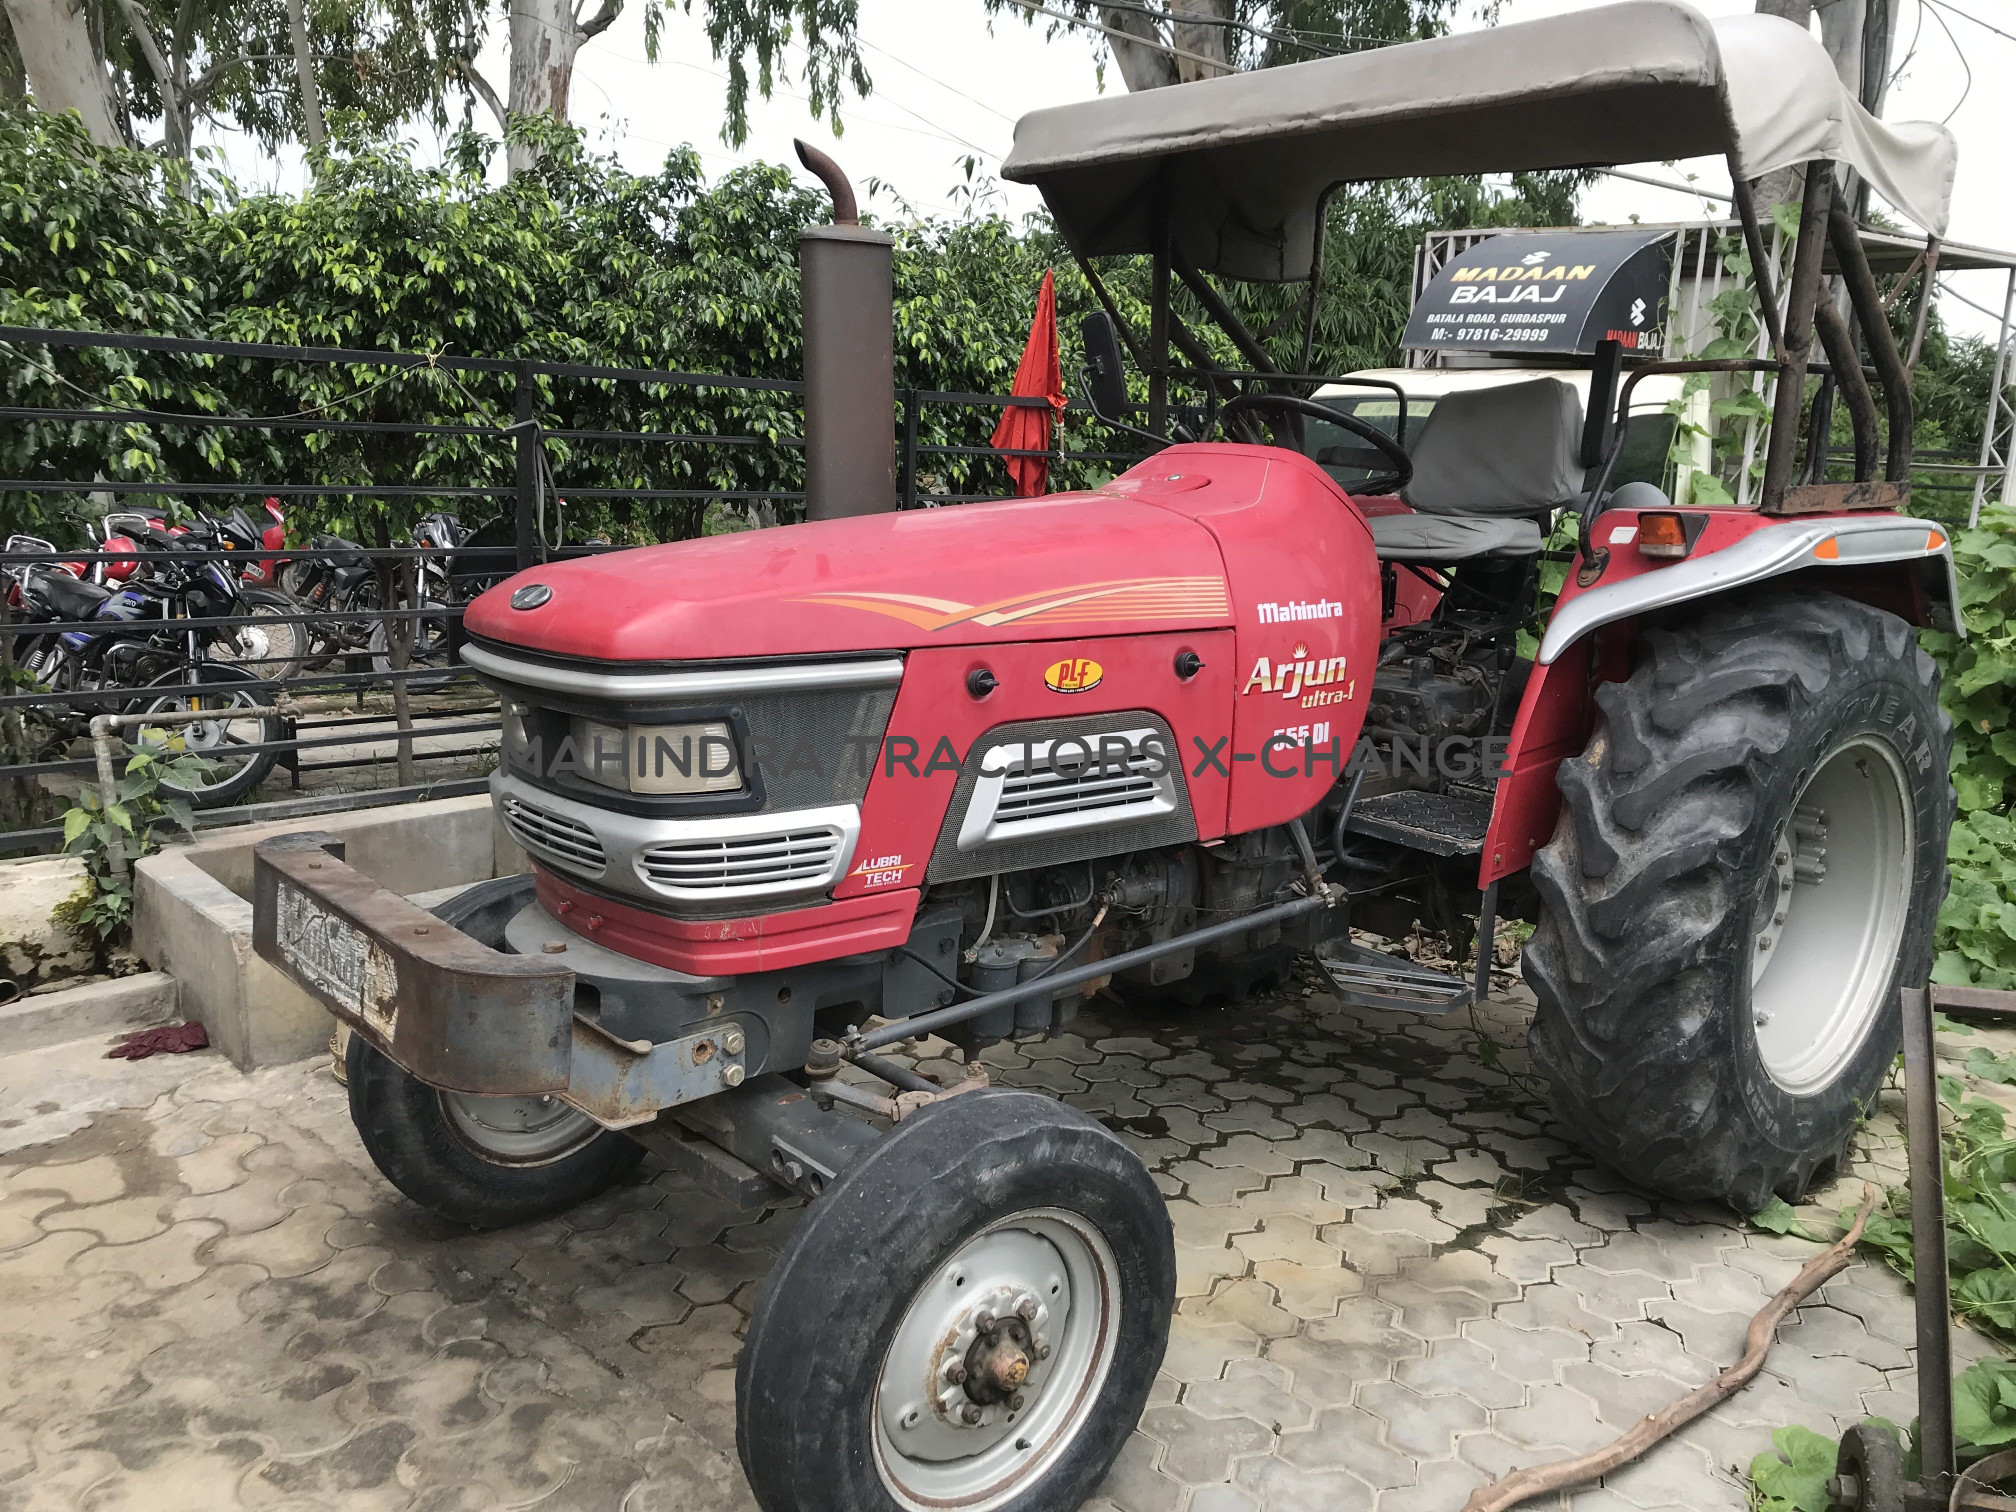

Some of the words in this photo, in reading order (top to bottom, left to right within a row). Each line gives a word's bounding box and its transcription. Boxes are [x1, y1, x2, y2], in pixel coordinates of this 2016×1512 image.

[1450, 265, 1596, 282] MADAAN
[1449, 285, 1567, 304] BAJAJ
[1426, 314, 1464, 324] BATALA
[1466, 314, 1497, 324] ROAD,
[1500, 313, 1567, 324] GURDASPUR
[1456, 328, 1549, 341] 97816-29999
[1637, 331, 1663, 351] BAJAJ
[1257, 598, 1343, 624] Mahindra
[1242, 656, 1347, 699] Arjun
[1301, 679, 1356, 709] ultra-1
[1312, 721, 1330, 744] DI
[863, 855, 902, 870] LUBRI
[865, 869, 903, 885] TECH
